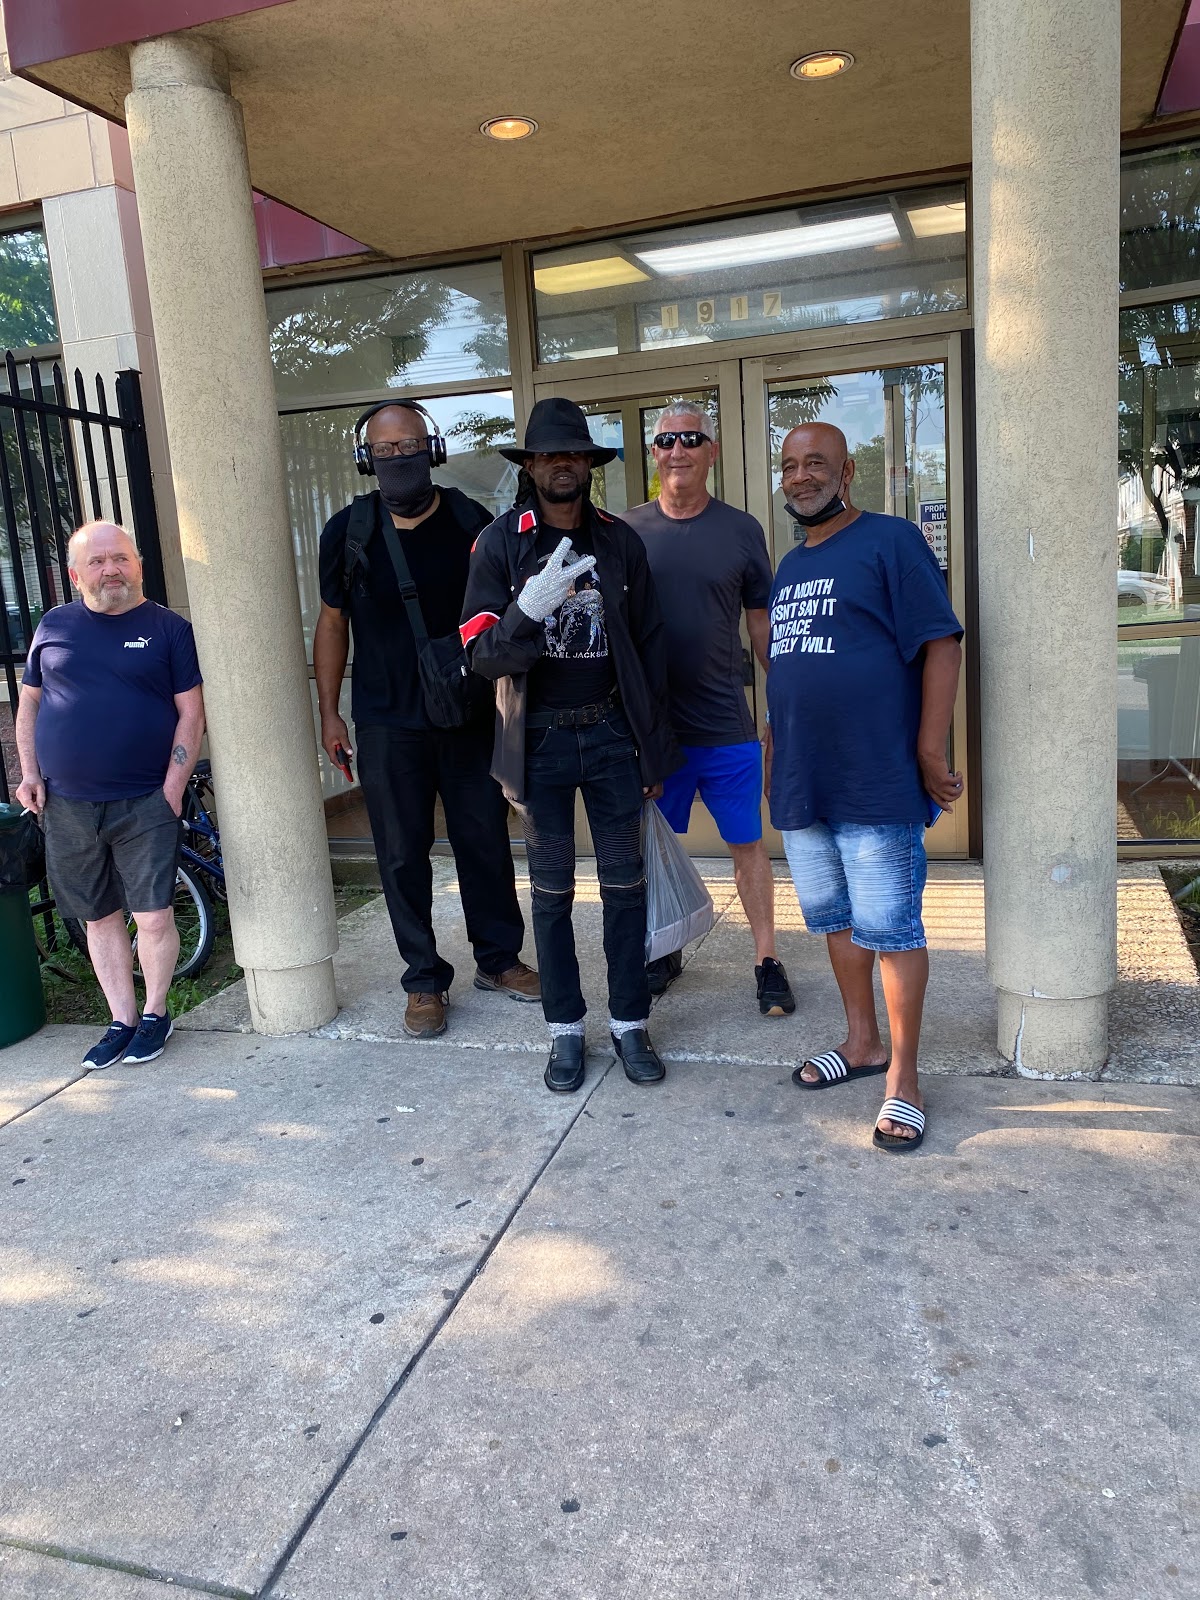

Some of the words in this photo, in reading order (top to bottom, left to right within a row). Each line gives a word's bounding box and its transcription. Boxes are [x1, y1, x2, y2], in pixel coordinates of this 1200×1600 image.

[666, 294, 779, 327] 1917
[793, 579, 834, 599] MOUTH
[798, 599, 820, 617] SAY
[822, 598, 837, 616] IT
[784, 619, 812, 637] FACE
[124, 641, 145, 649] PUMA
[801, 637, 835, 653] WILL
